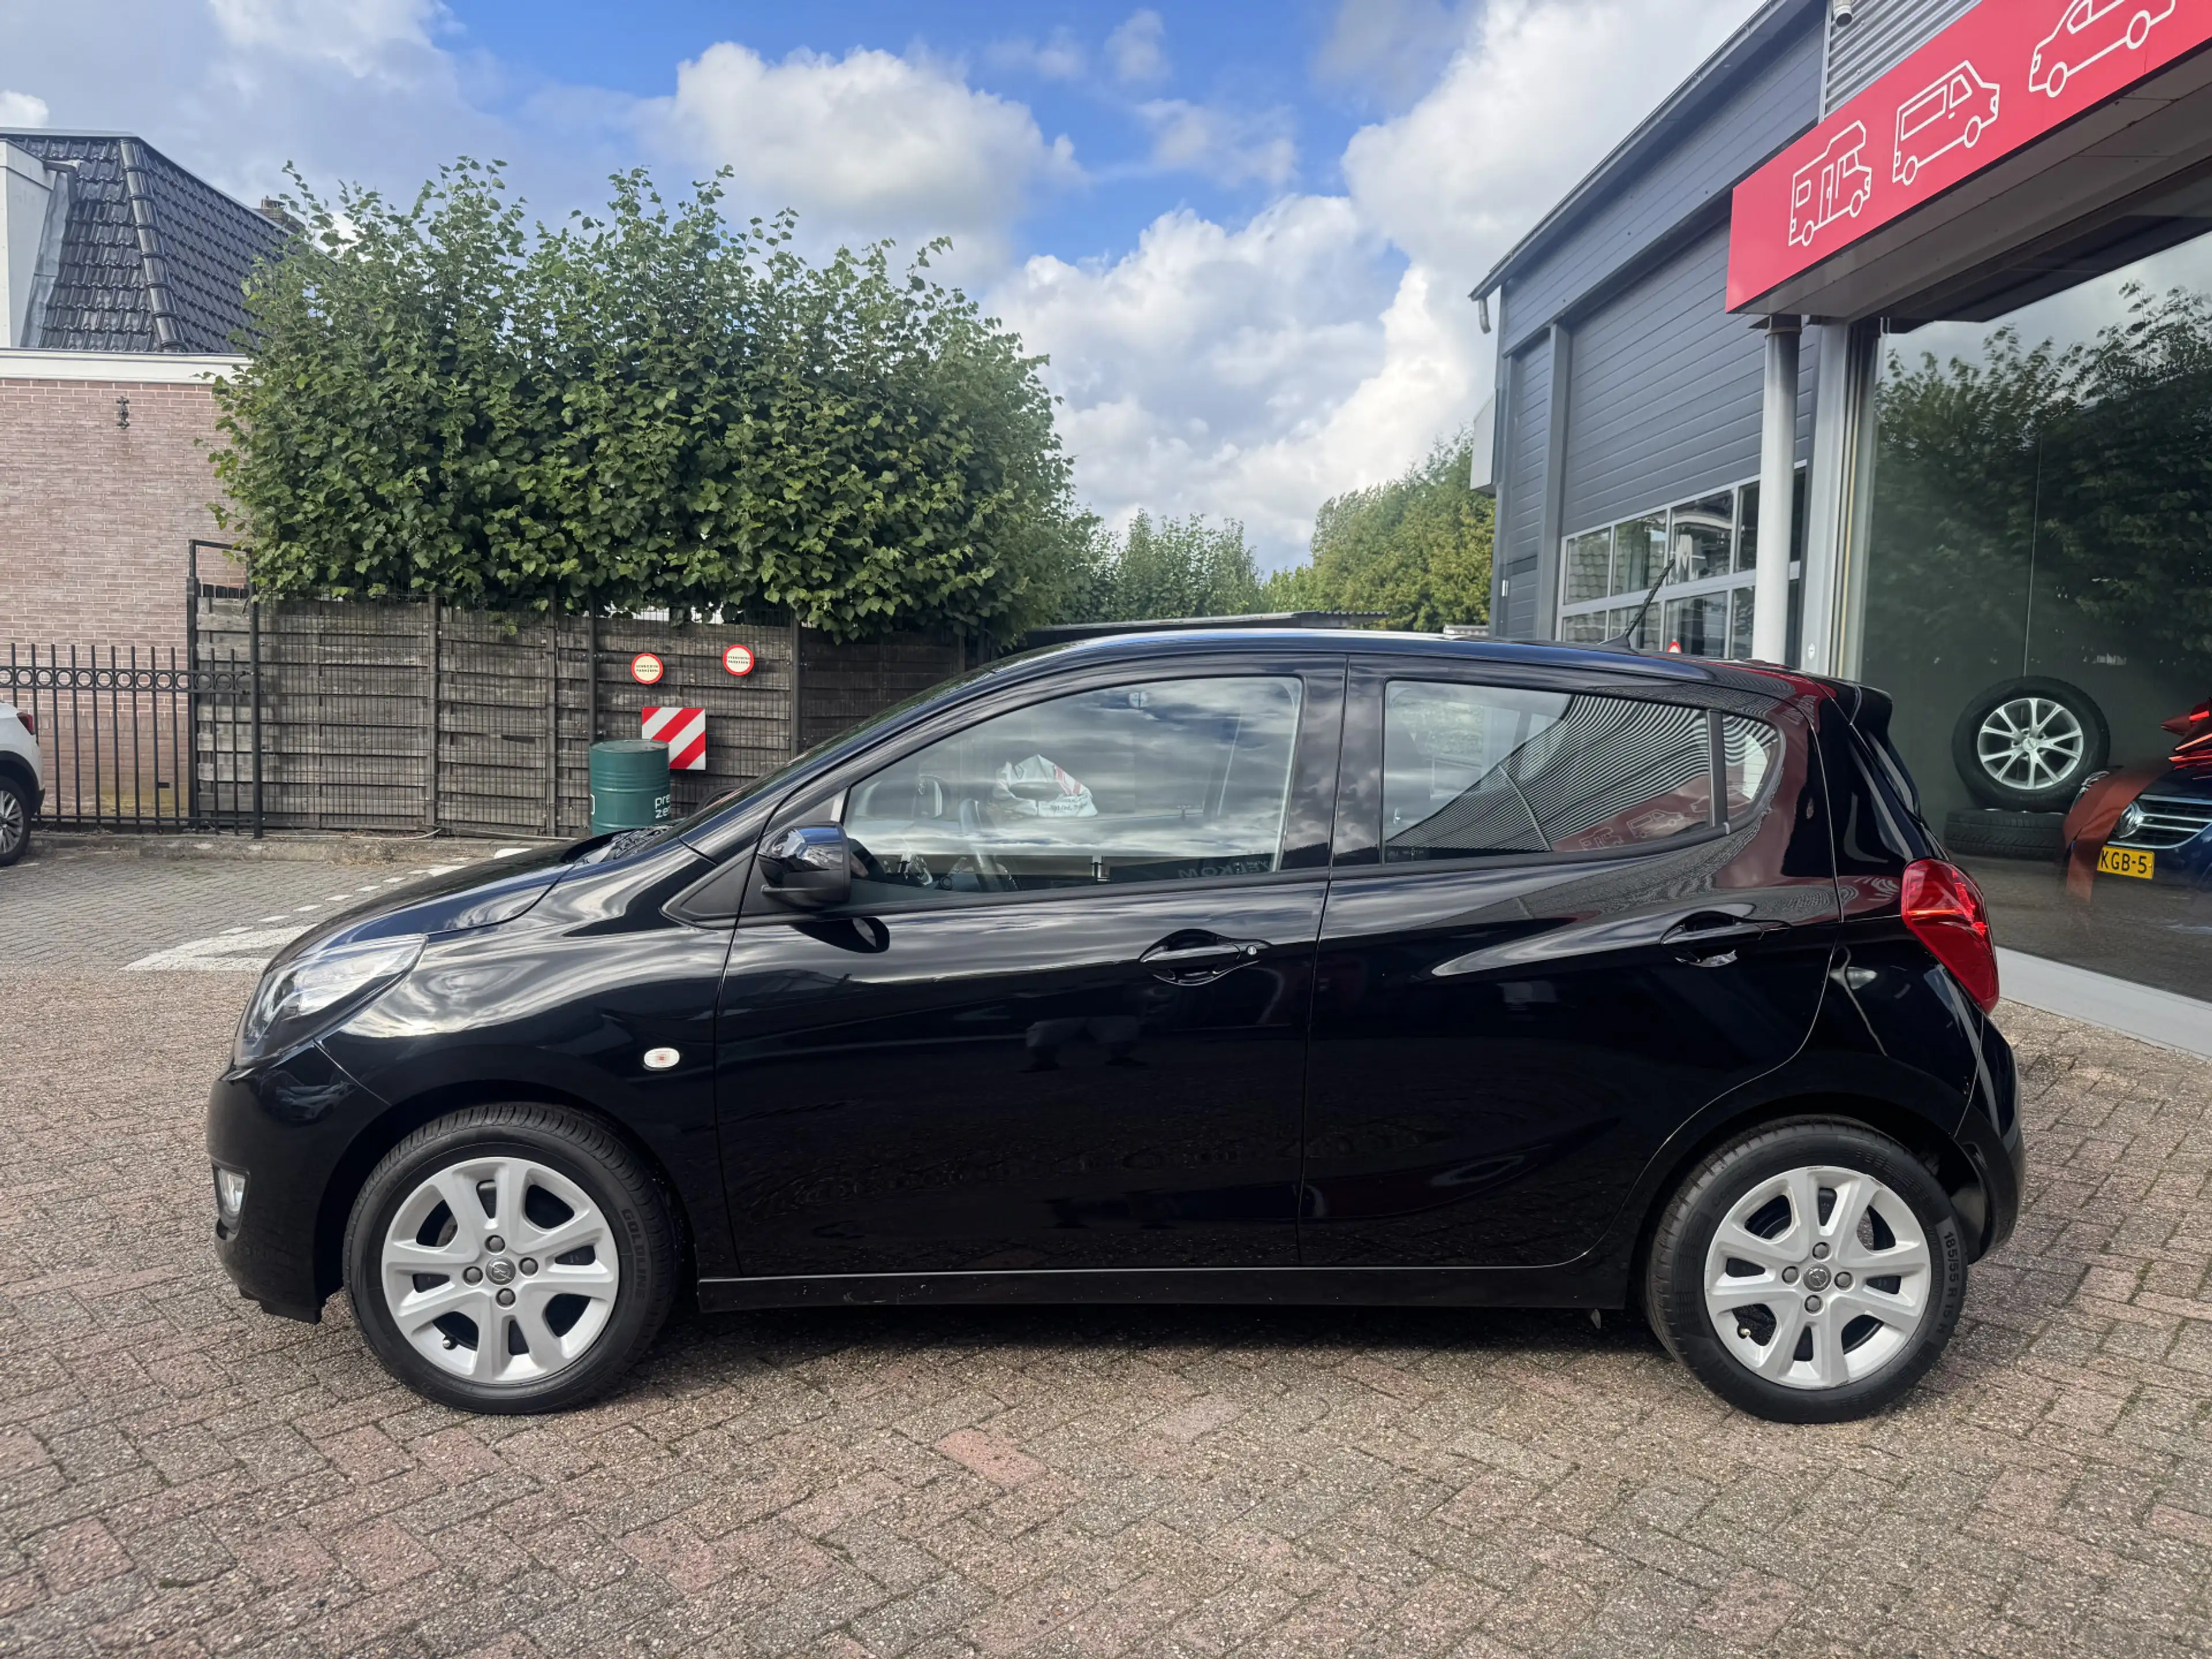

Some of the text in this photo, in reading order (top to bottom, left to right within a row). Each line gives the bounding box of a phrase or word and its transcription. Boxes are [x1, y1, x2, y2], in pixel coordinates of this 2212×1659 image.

[2101, 850, 2147, 874] KGB-5
[622, 1209, 647, 1299] GOLDLINE
[1944, 1230, 1959, 1283] 185/55
[1948, 1287, 1957, 1297] R
[1942, 1304, 1954, 1318] 15
